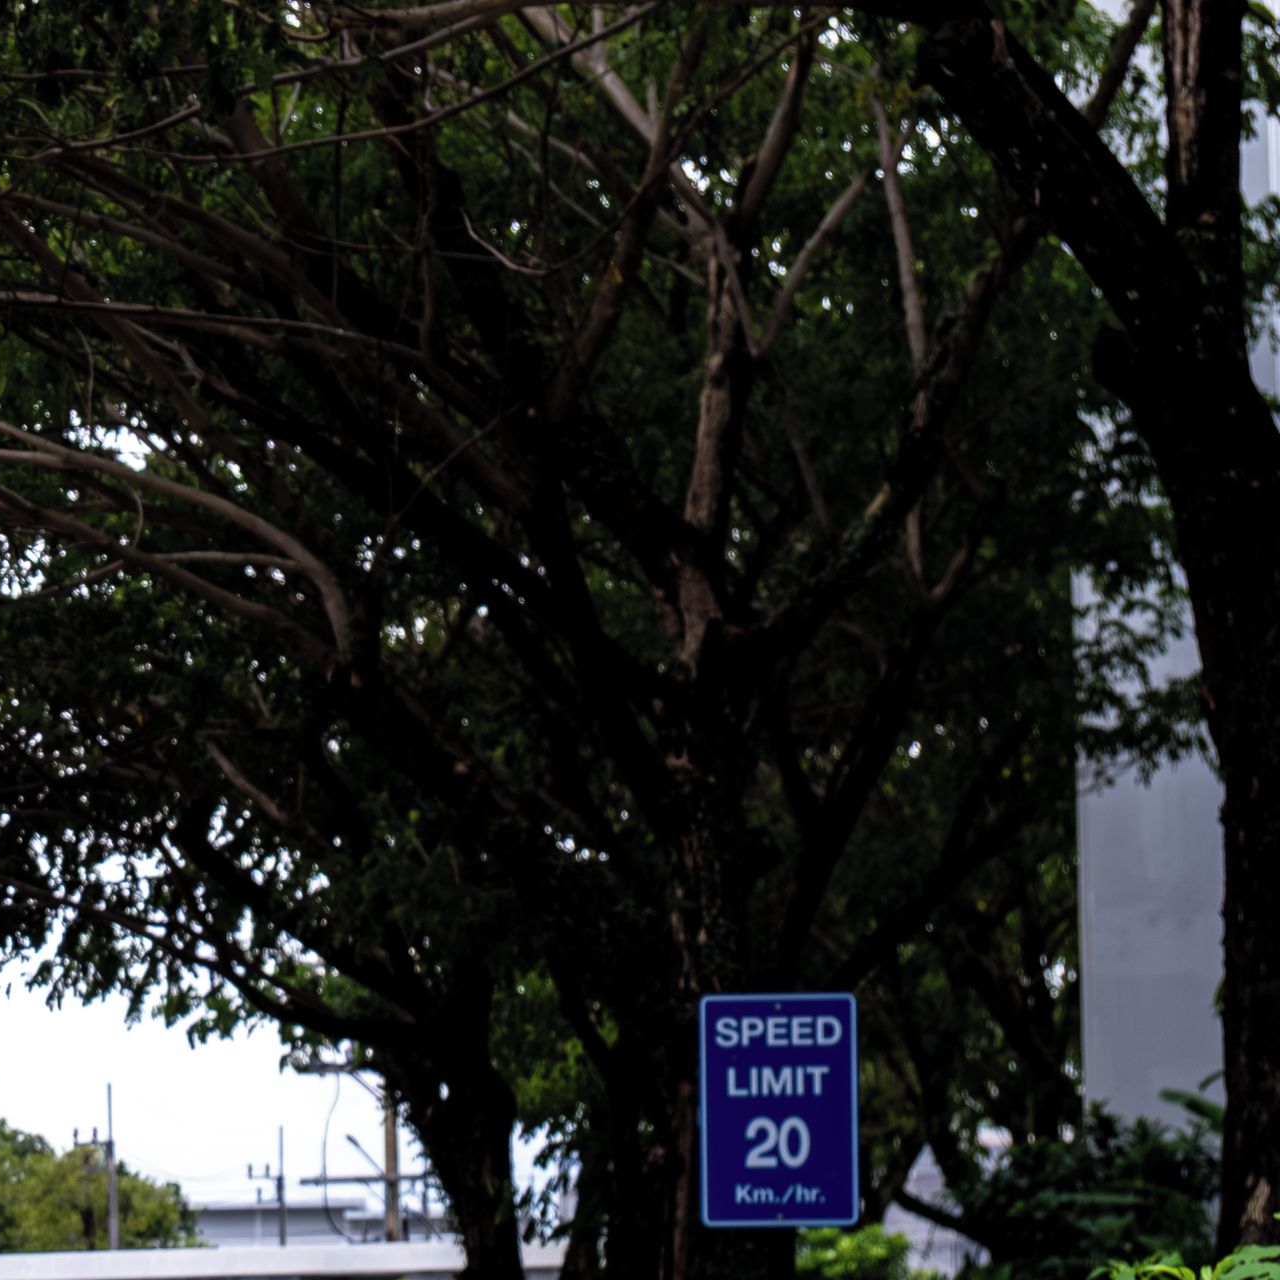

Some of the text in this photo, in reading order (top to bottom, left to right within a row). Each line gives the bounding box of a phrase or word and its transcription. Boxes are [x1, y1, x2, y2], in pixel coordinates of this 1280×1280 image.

[715, 1015, 842, 1048] SPEED
[727, 1065, 830, 1097] LIMIT
[744, 1116, 811, 1169] 20
[734, 1183, 827, 1206] Km./hr.
